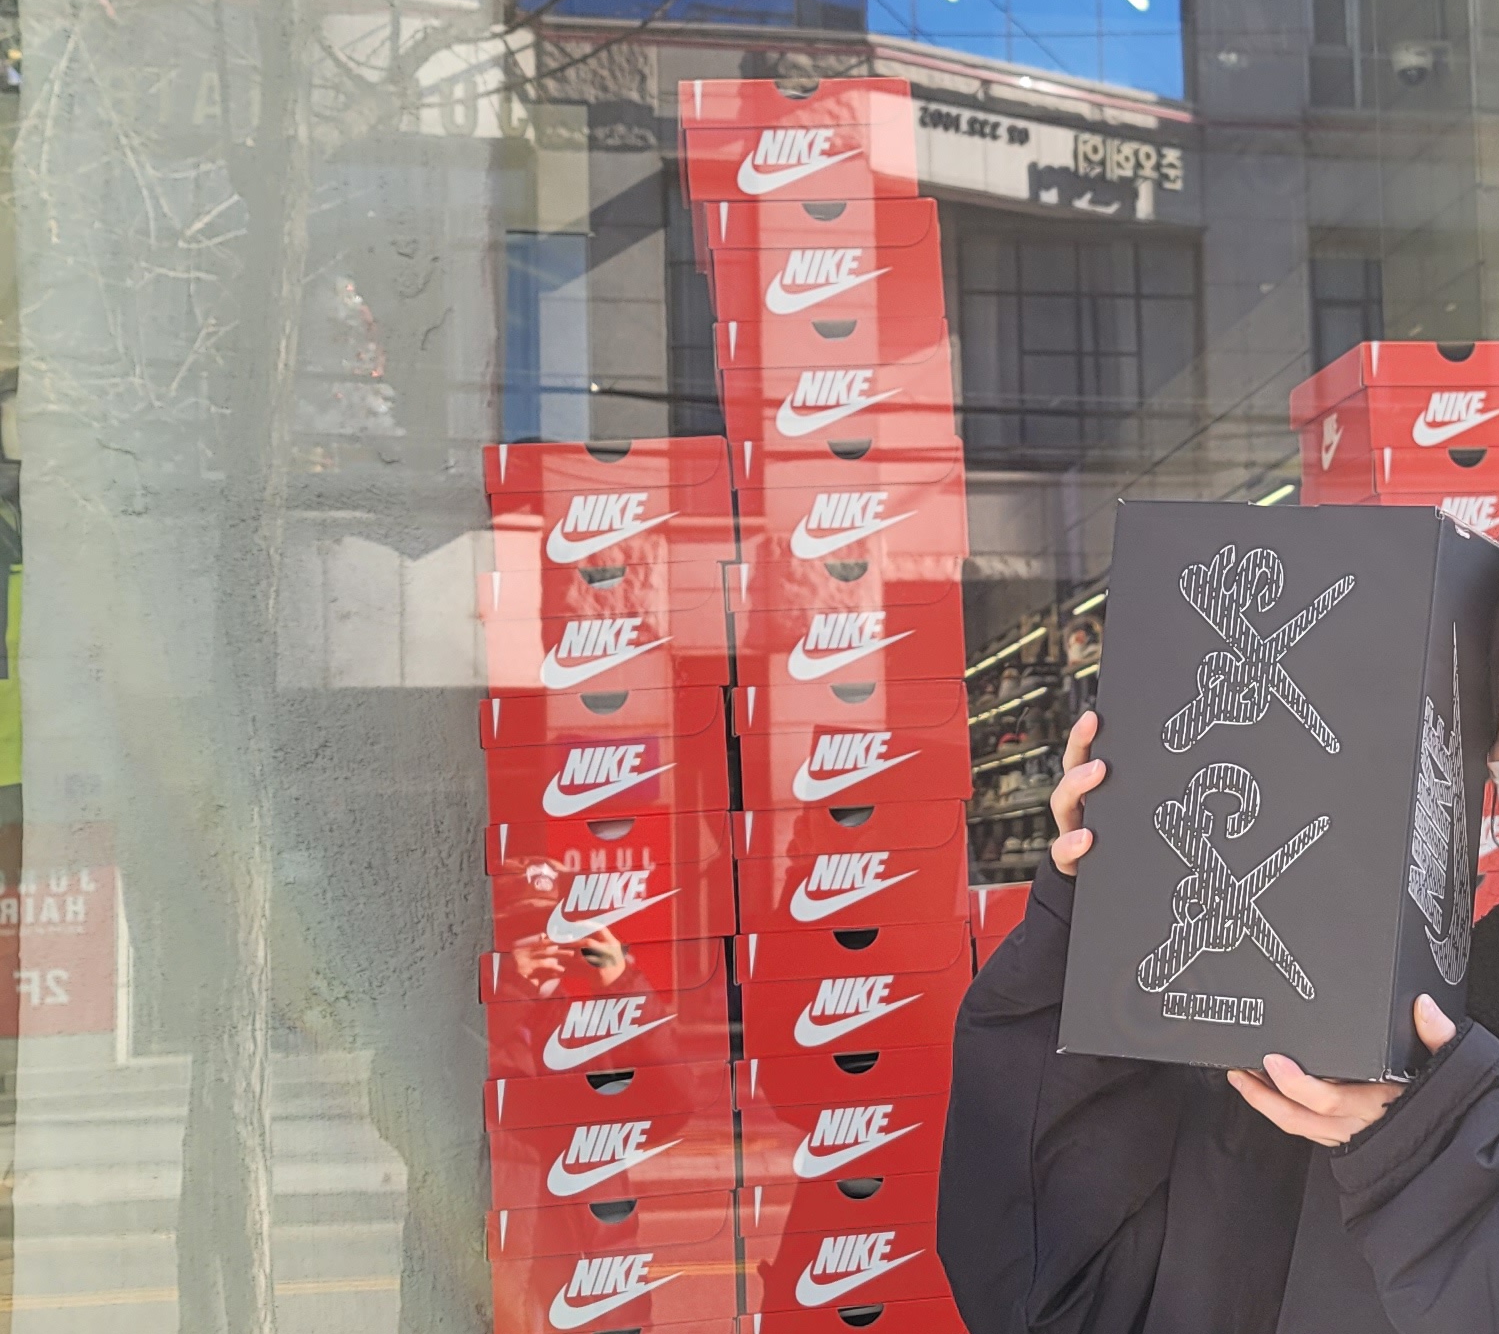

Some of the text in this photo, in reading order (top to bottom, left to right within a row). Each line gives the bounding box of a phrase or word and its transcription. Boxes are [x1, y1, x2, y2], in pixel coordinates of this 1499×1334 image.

[756, 129, 833, 165] NIKE
[785, 249, 862, 285] NIKE
[795, 370, 874, 406] NIKE
[1426, 391, 1486, 422] NIKE
[565, 493, 647, 531] NIKE
[808, 492, 888, 528] NIKE
[559, 618, 642, 657] NIKE
[805, 611, 887, 648] NIKE
[561, 745, 645, 785] NIKE
[811, 731, 891, 769] NIKE
[808, 852, 889, 889] NIKE
[566, 870, 650, 912] NIKE
[813, 975, 893, 1014] NIKE
[561, 997, 646, 1038] NIKE
[567, 1121, 651, 1163] NIKE
[812, 1104, 893, 1144] NIKE
[817, 1232, 894, 1274] NIKE
[566, 1254, 650, 1295] NIKE
